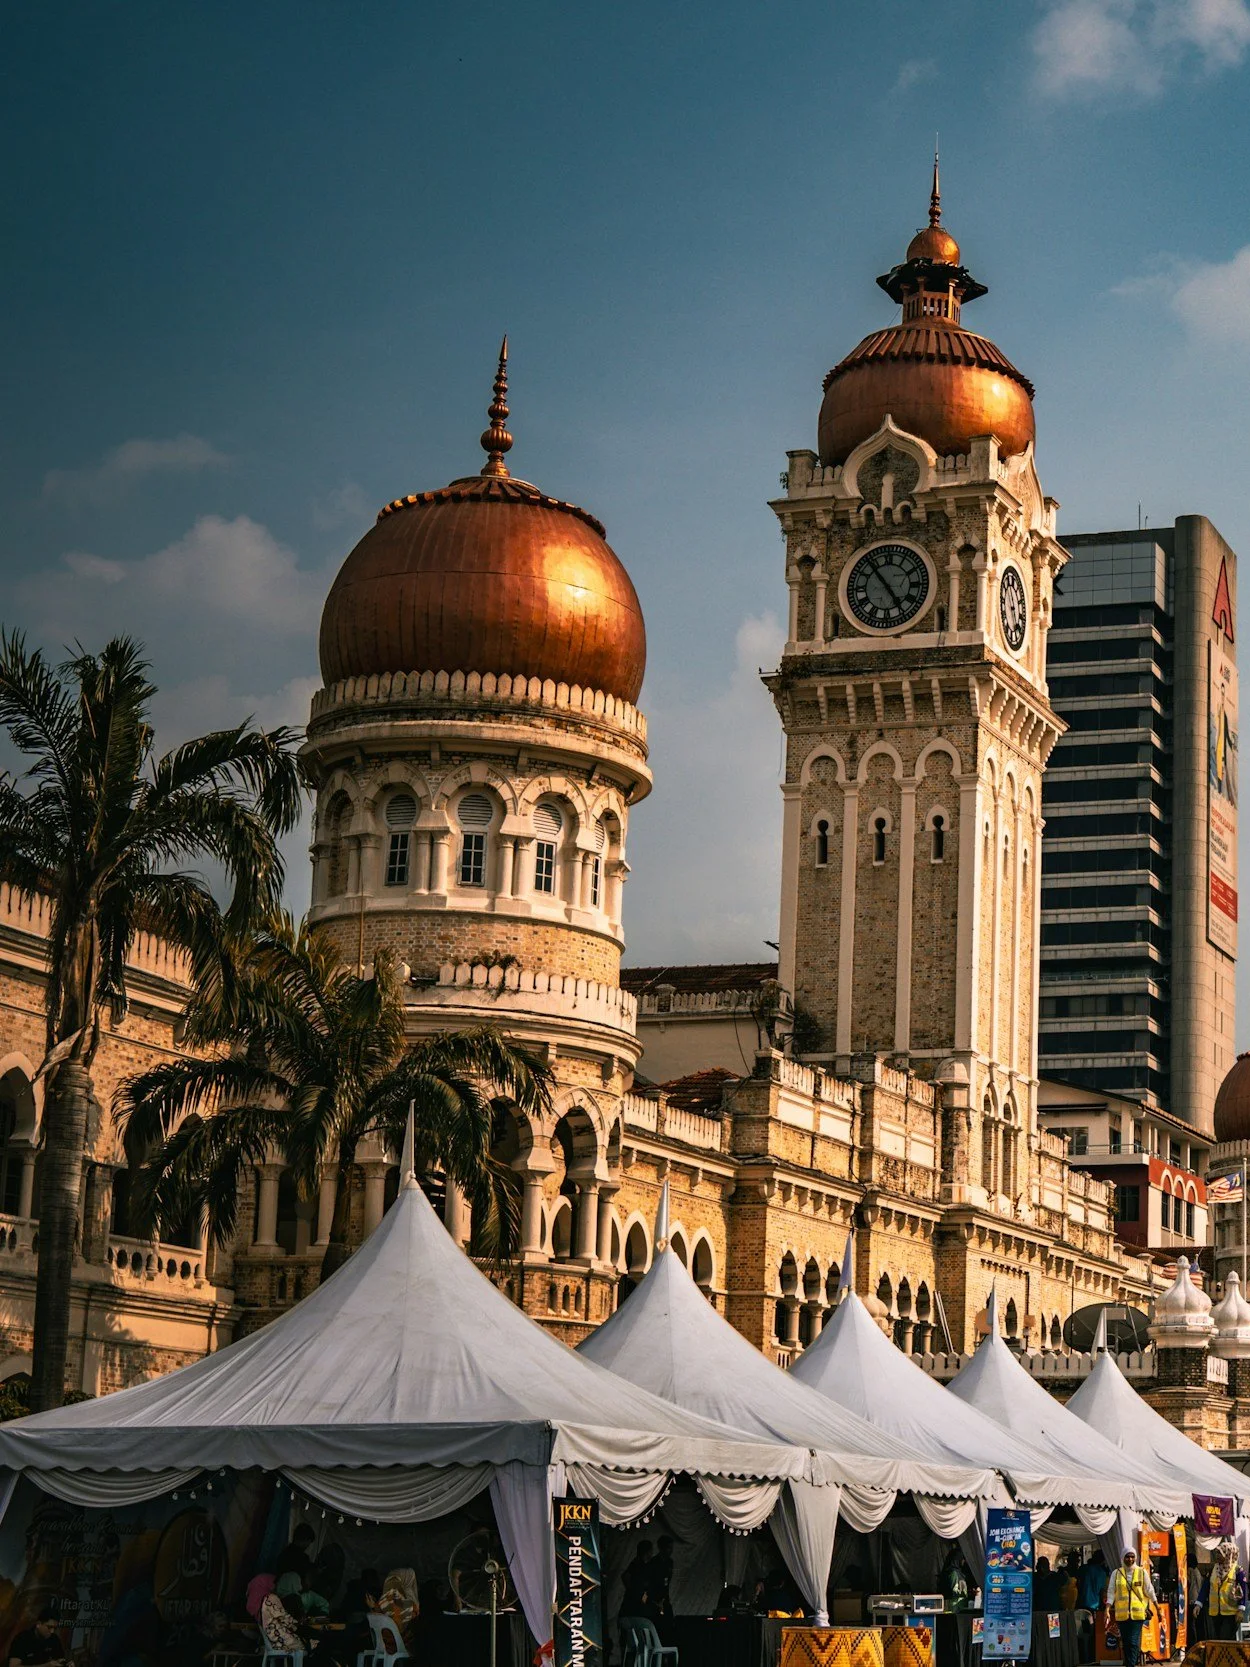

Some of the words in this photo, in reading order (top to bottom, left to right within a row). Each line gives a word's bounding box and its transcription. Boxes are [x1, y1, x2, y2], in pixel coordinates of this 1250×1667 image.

[558, 1504, 592, 1530] JKKN
[1000, 1526, 1025, 1535] EXCHANGE
[568, 1536, 584, 1654] PENDAFTARAN
